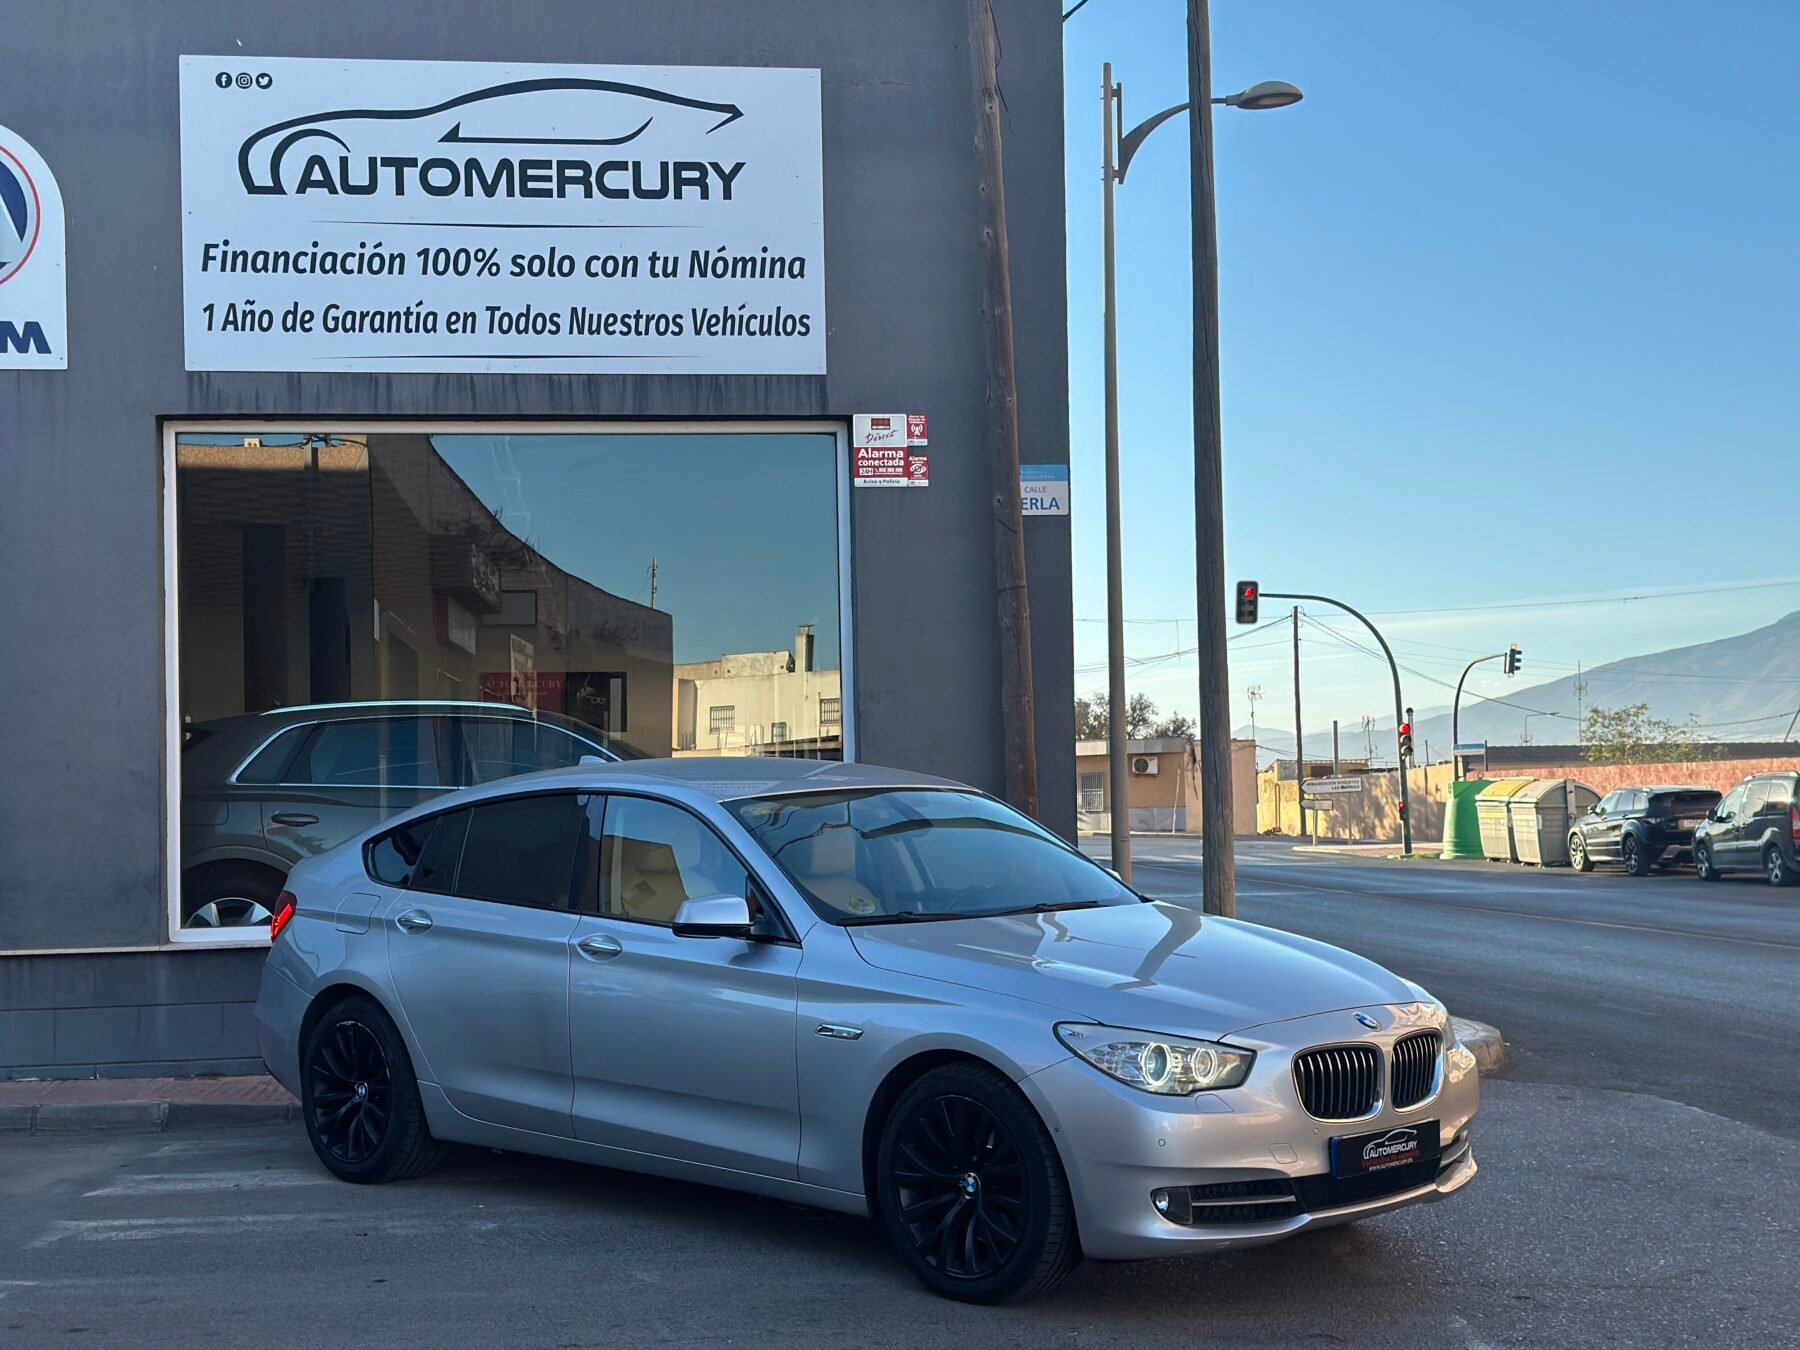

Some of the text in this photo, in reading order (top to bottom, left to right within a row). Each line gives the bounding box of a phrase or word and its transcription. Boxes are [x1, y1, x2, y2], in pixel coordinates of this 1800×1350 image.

[295, 154, 747, 201] AUTOMERCURY
[201, 238, 806, 280] Financiación 100% solo con tu Nómina
[202, 299, 812, 338] 1 Año de Garantía en Todos Nuestros Vehículos
[858, 448, 904, 458] Alarma
[858, 458, 905, 467] conectada
[1369, 1141, 1418, 1159] AUTOMERCURY
